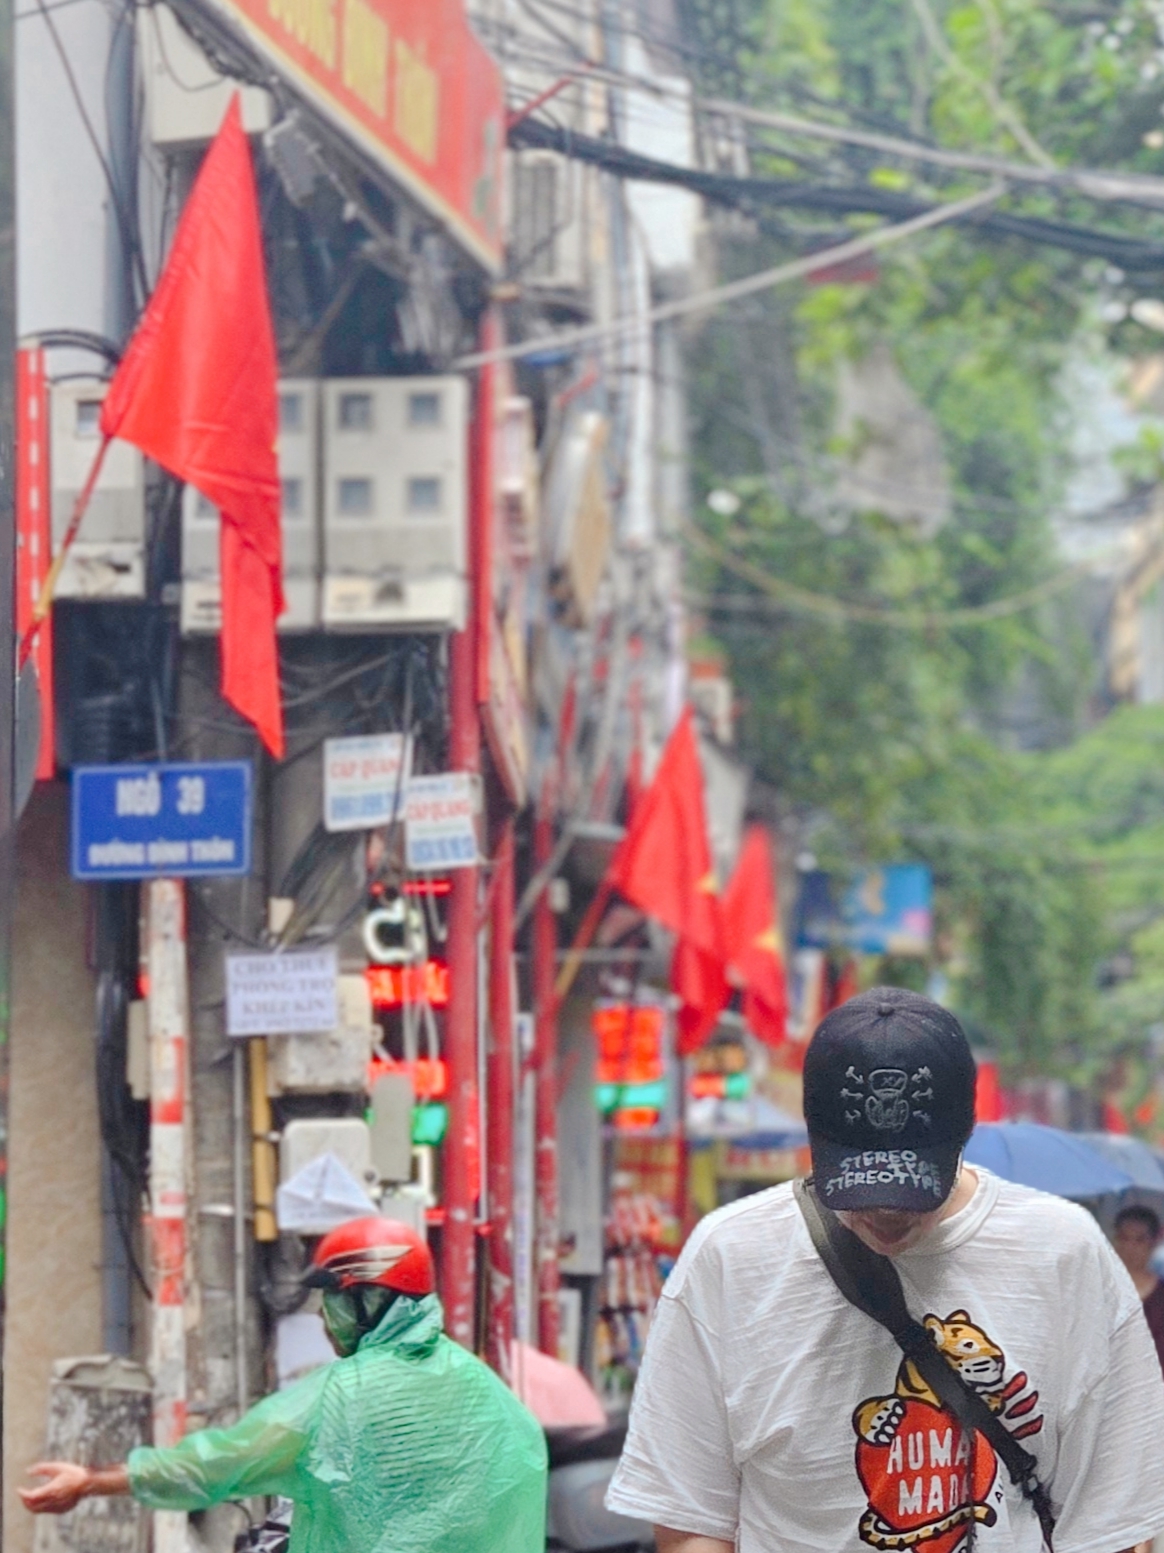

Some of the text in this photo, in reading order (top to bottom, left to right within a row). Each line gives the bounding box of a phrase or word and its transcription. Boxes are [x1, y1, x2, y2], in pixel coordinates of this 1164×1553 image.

[177, 776, 205, 815] 39
[840, 1149, 917, 1175] STEREO
[825, 1169, 943, 1199] STEREOTYPE
